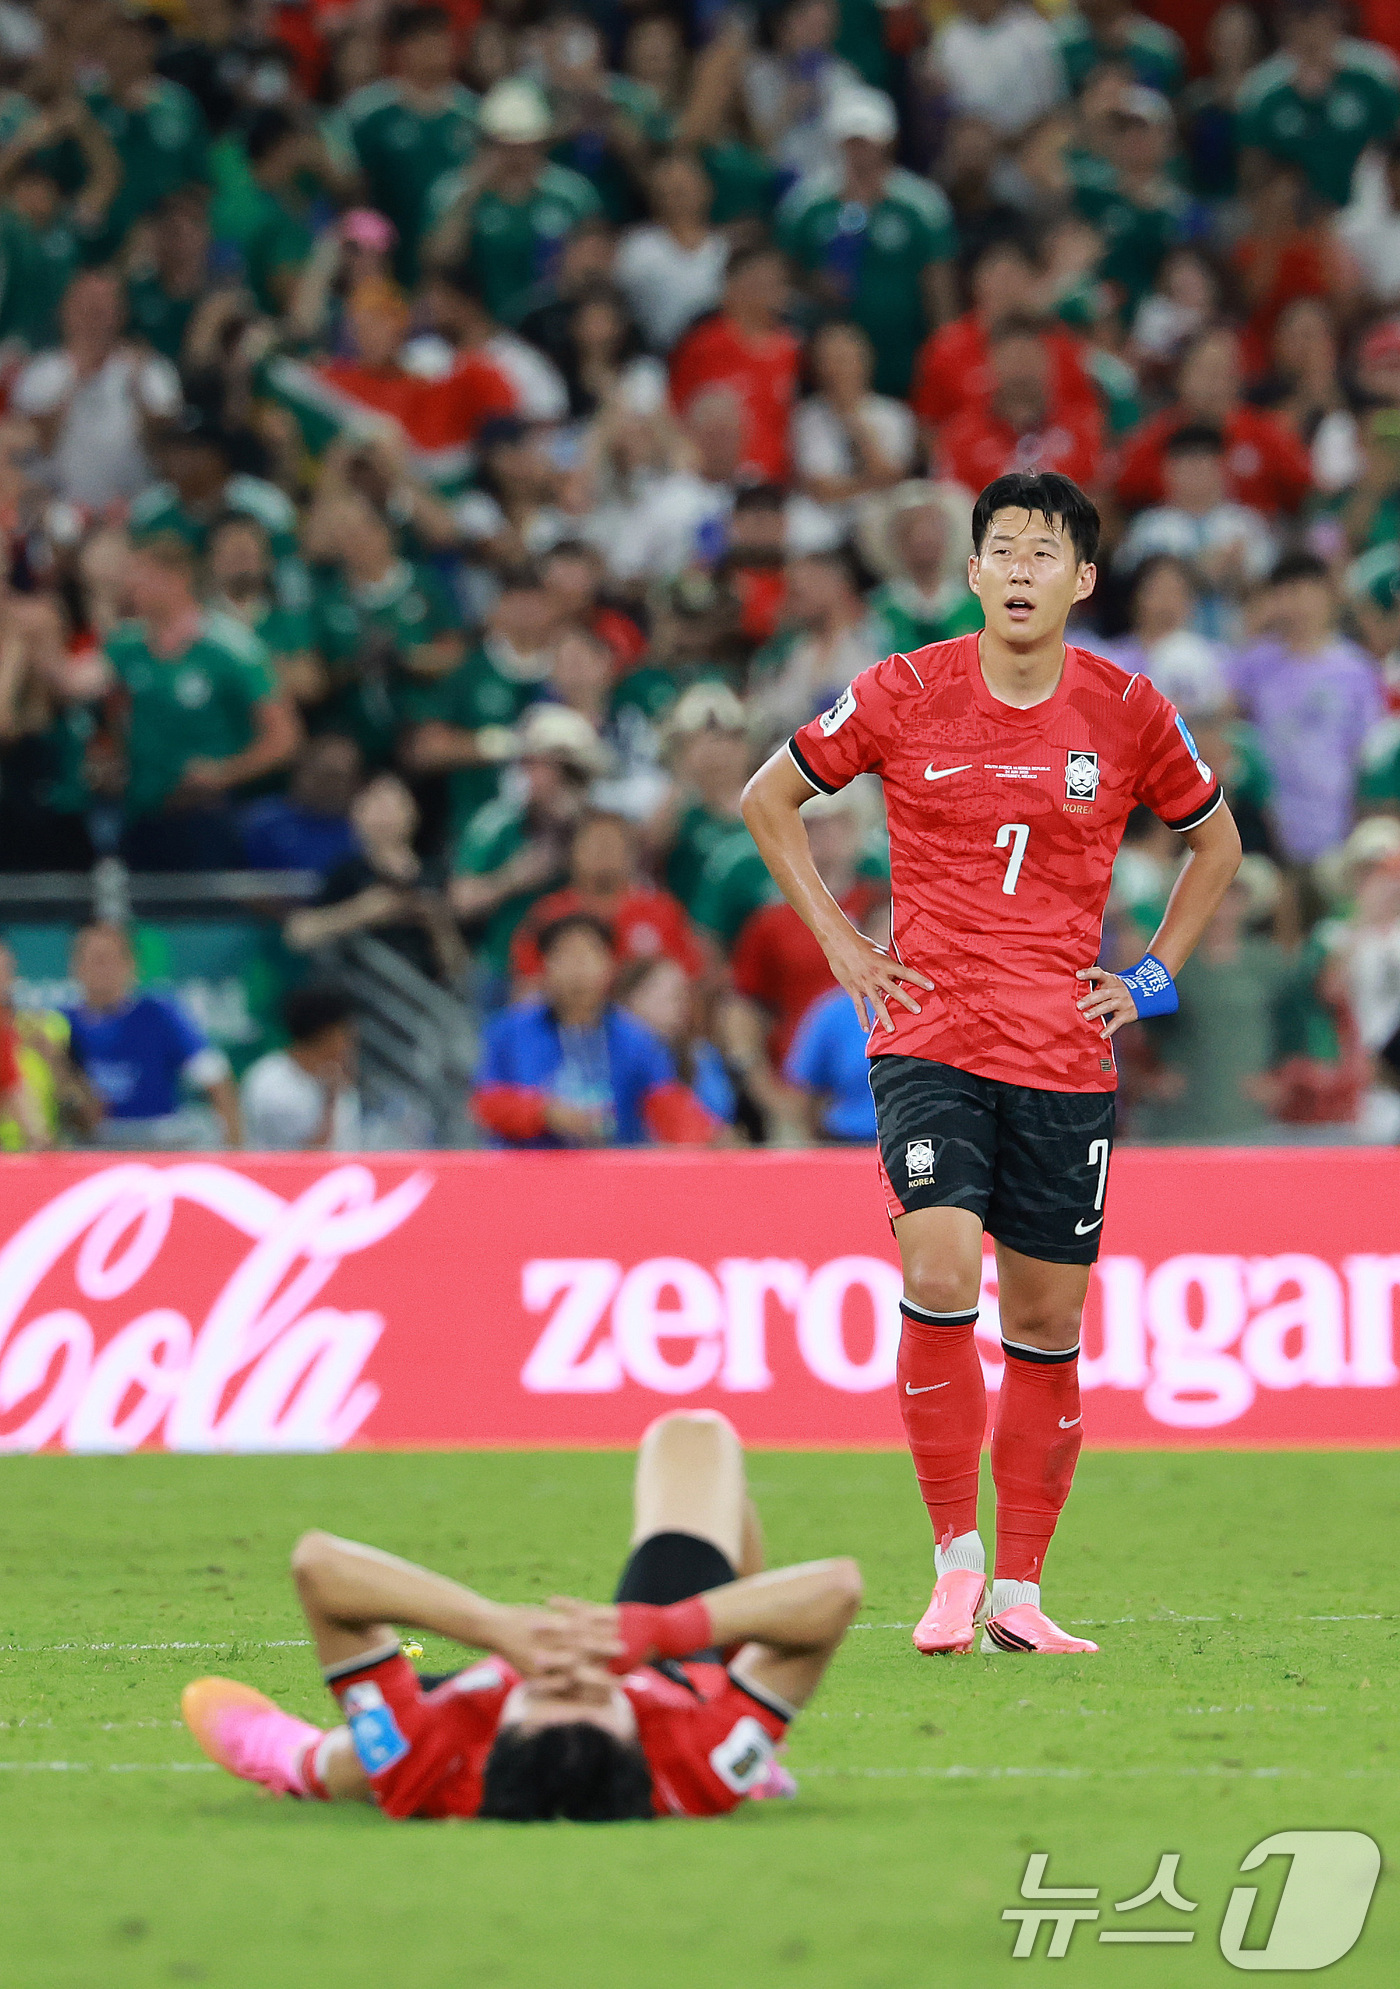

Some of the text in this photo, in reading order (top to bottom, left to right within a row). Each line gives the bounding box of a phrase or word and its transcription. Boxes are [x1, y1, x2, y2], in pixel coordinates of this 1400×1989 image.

[1062, 803, 1094, 815] KOREA
[993, 823, 1031, 896] 7
[1143, 958, 1171, 989] FOOTBALL
[908, 1177, 936, 1188] KOREA
[1086, 1138, 1109, 1211] 7
[519, 1254, 903, 1393] zero
